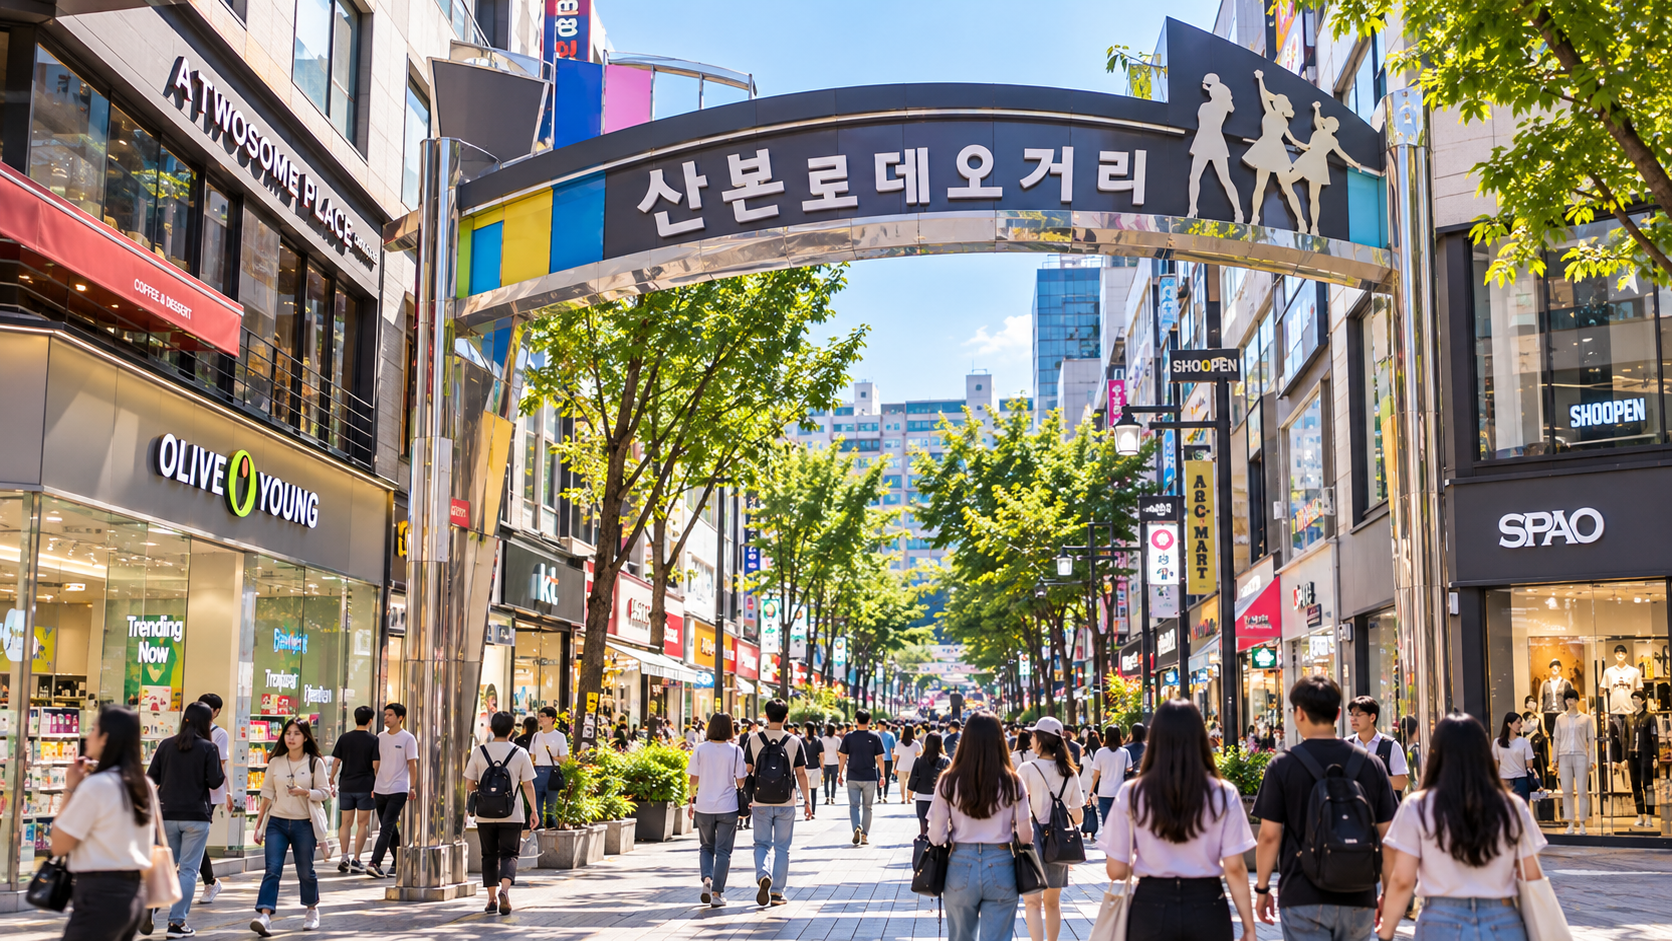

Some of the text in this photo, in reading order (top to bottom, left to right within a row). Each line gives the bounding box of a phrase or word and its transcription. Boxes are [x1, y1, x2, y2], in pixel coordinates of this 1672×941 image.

[170, 56, 354, 248] A TWOSOME PLACE
[637, 144, 1148, 238] 산본로데오거리
[1172, 358, 1239, 374] SHOOPEN
[1570, 398, 1646, 428] SHOOPEN
[157, 433, 320, 529] OLIVE YOUNG
[1498, 507, 1605, 549] SPAO
[540, 563, 559, 606] kt
[127, 615, 184, 642] Trending
[138, 641, 170, 664] Now
